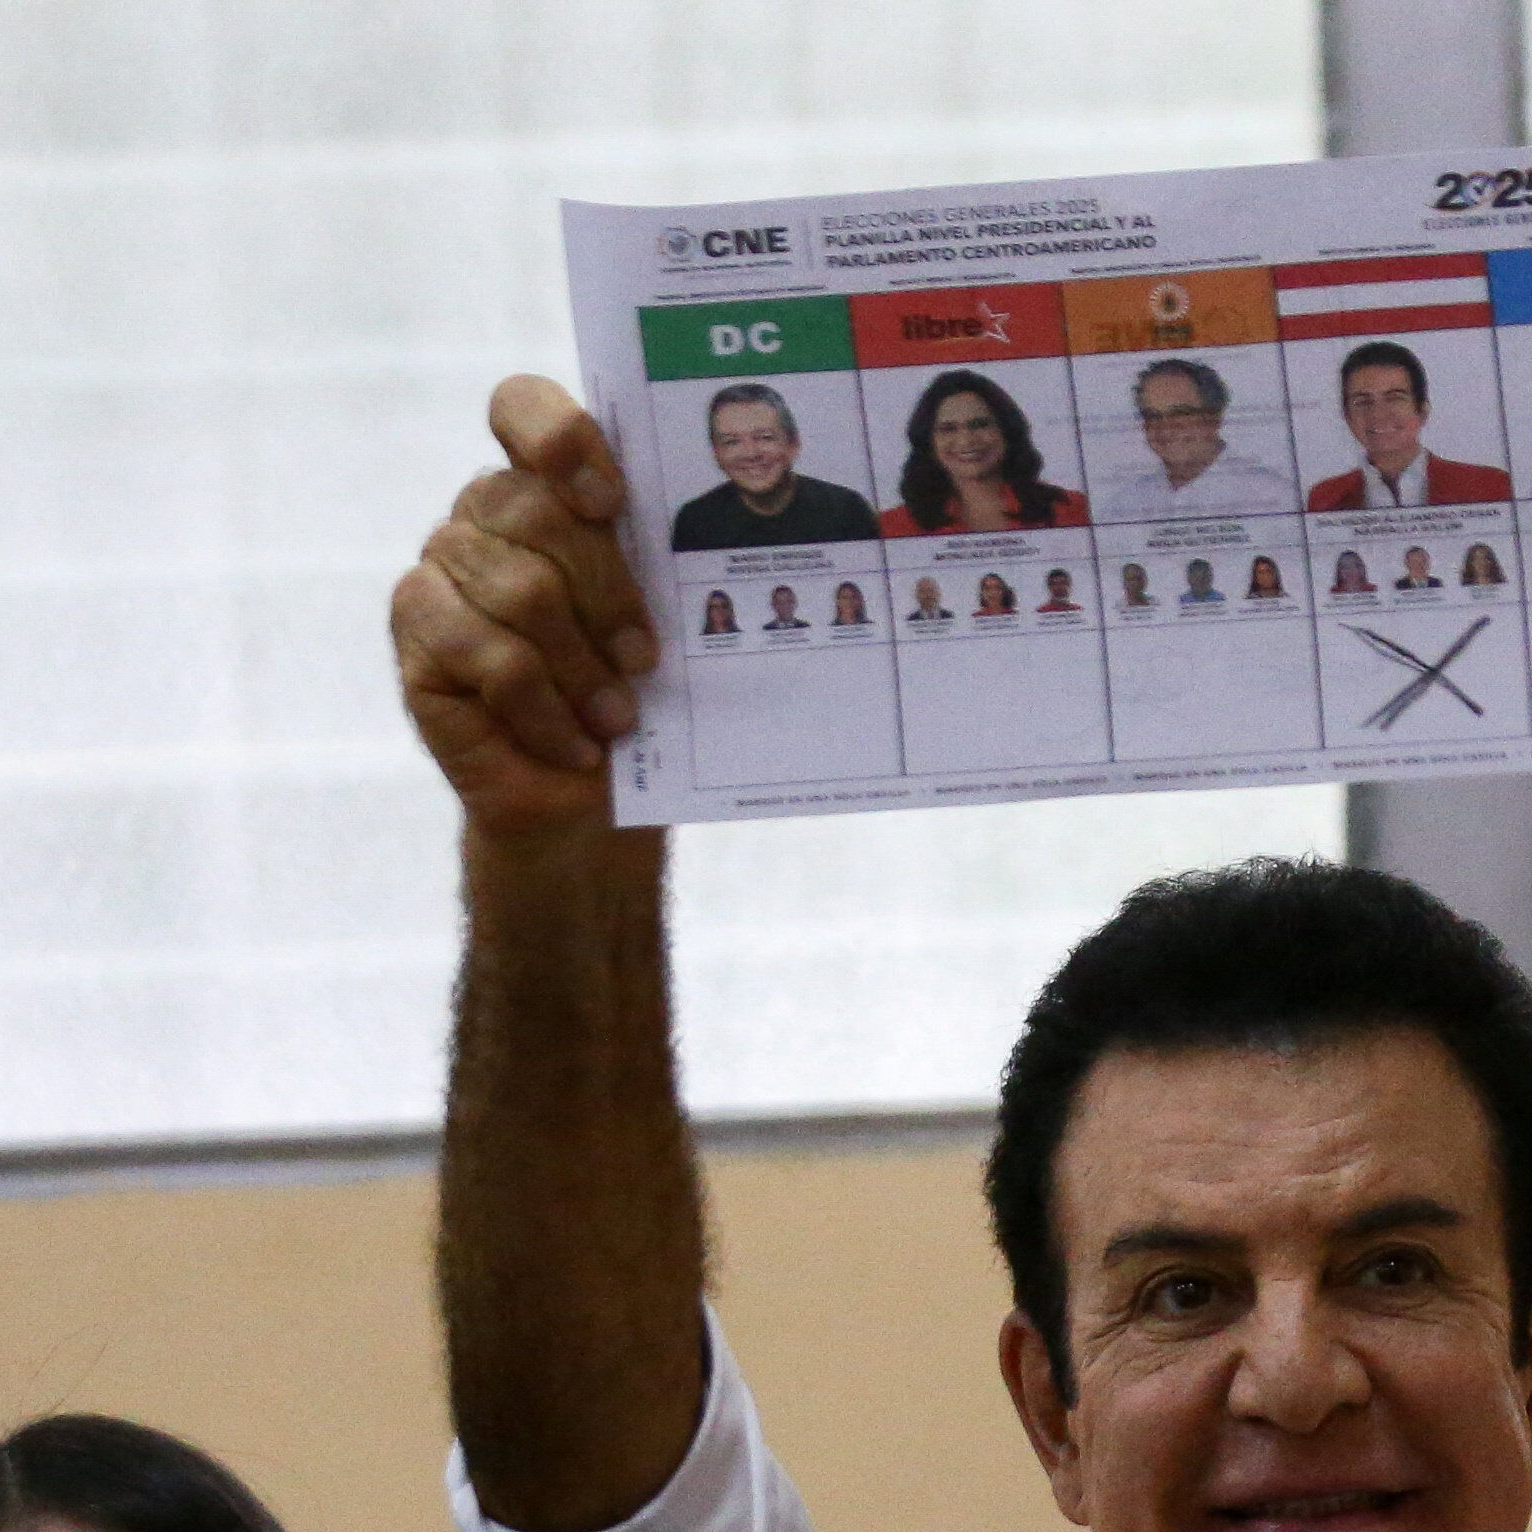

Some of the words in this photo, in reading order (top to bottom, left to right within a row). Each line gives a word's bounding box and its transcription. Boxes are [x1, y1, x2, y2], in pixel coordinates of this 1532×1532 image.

[820, 209, 939, 230] ELECCIONES
[943, 202, 1051, 222] GENERALES
[824, 230, 914, 247] PLANILLA
[917, 225, 973, 241] NIVEL
[976, 217, 1112, 238] PRESIDENCIAL
[1114, 215, 1127, 230] Y
[1132, 214, 1156, 229] AL
[702, 225, 791, 258] CNE
[824, 246, 958, 268] PARLAMENTO
[961, 234, 1158, 260] CENTROAMERICANO
[709, 320, 784, 357] DC
[901, 313, 984, 340] libre
